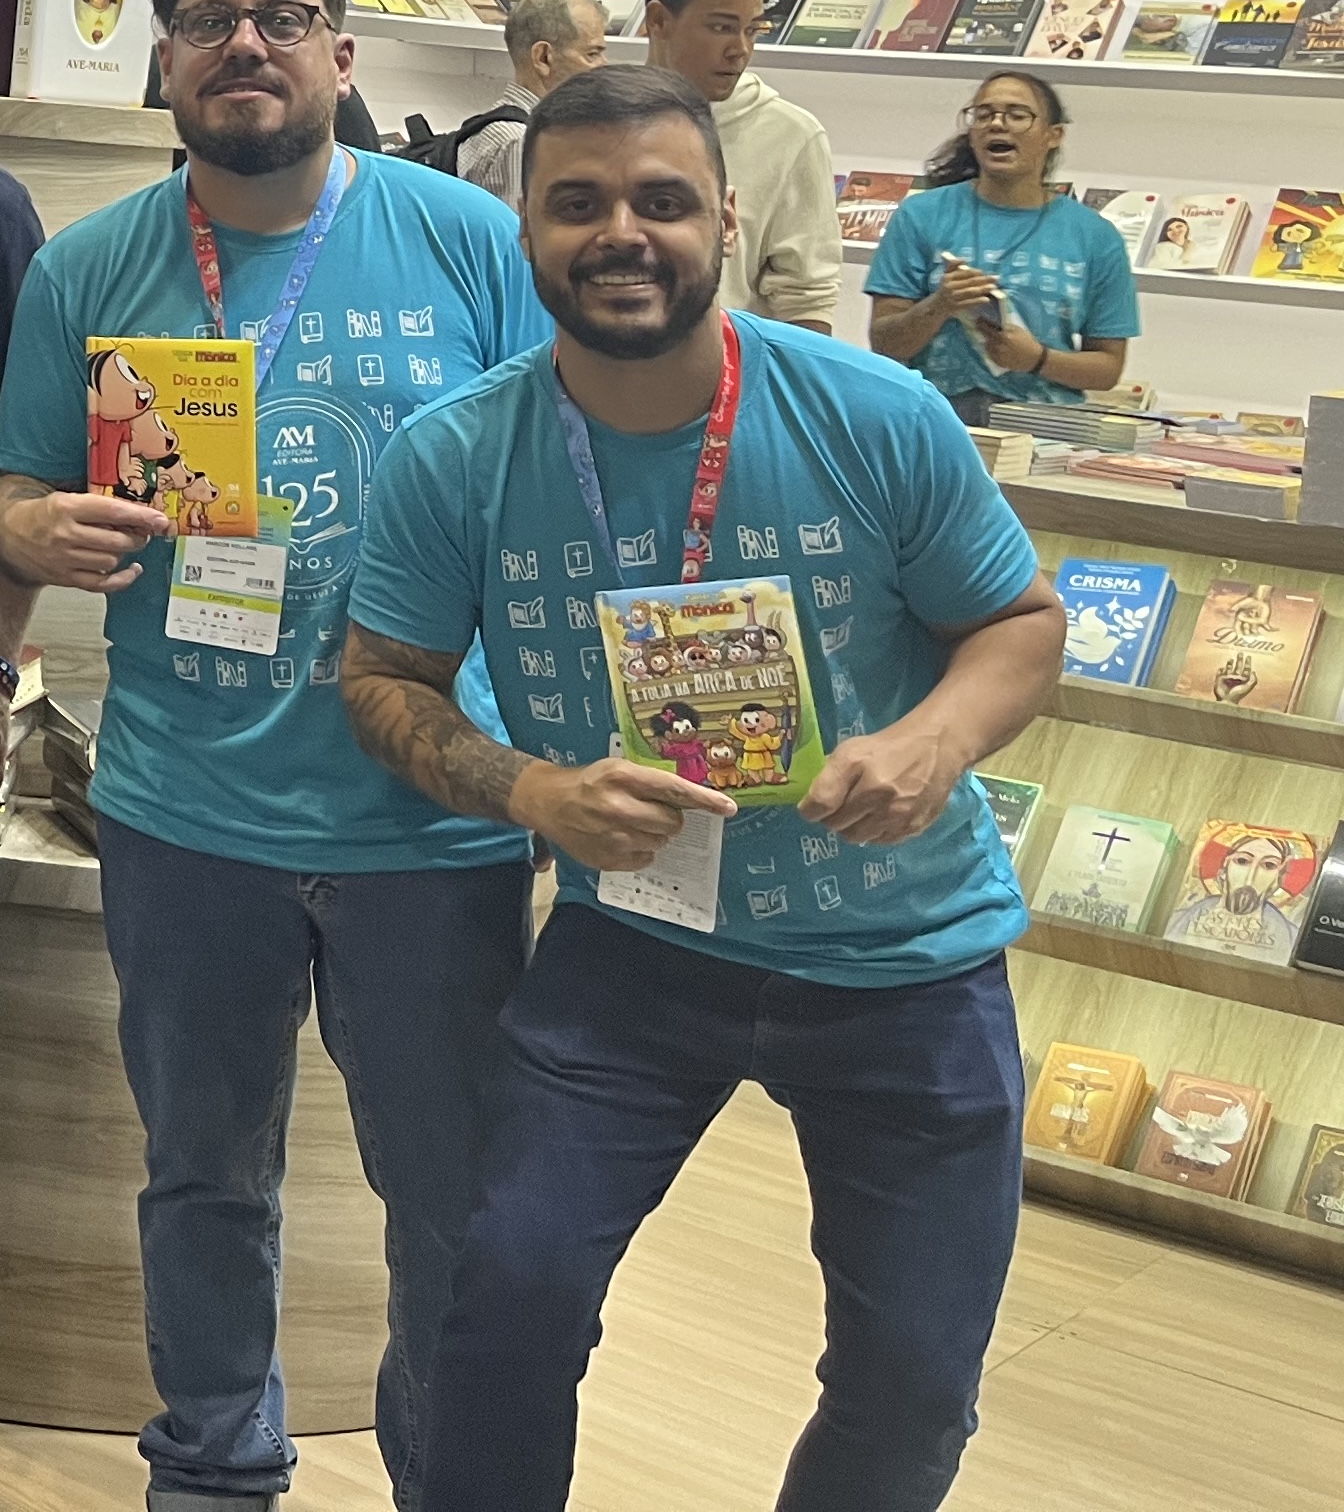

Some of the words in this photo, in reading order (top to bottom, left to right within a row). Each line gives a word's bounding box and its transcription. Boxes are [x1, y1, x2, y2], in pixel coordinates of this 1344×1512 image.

[65, 58, 120, 73] AVE-MARIA
[172, 373, 198, 386] Dia
[200, 376, 212, 387] a
[214, 374, 239, 387] dia
[189, 388, 223, 399] com
[173, 397, 239, 418] Jesus
[288, 556, 334, 571] NOS
[1069, 574, 1142, 592] CRISMA
[693, 669, 739, 695] ARCA
